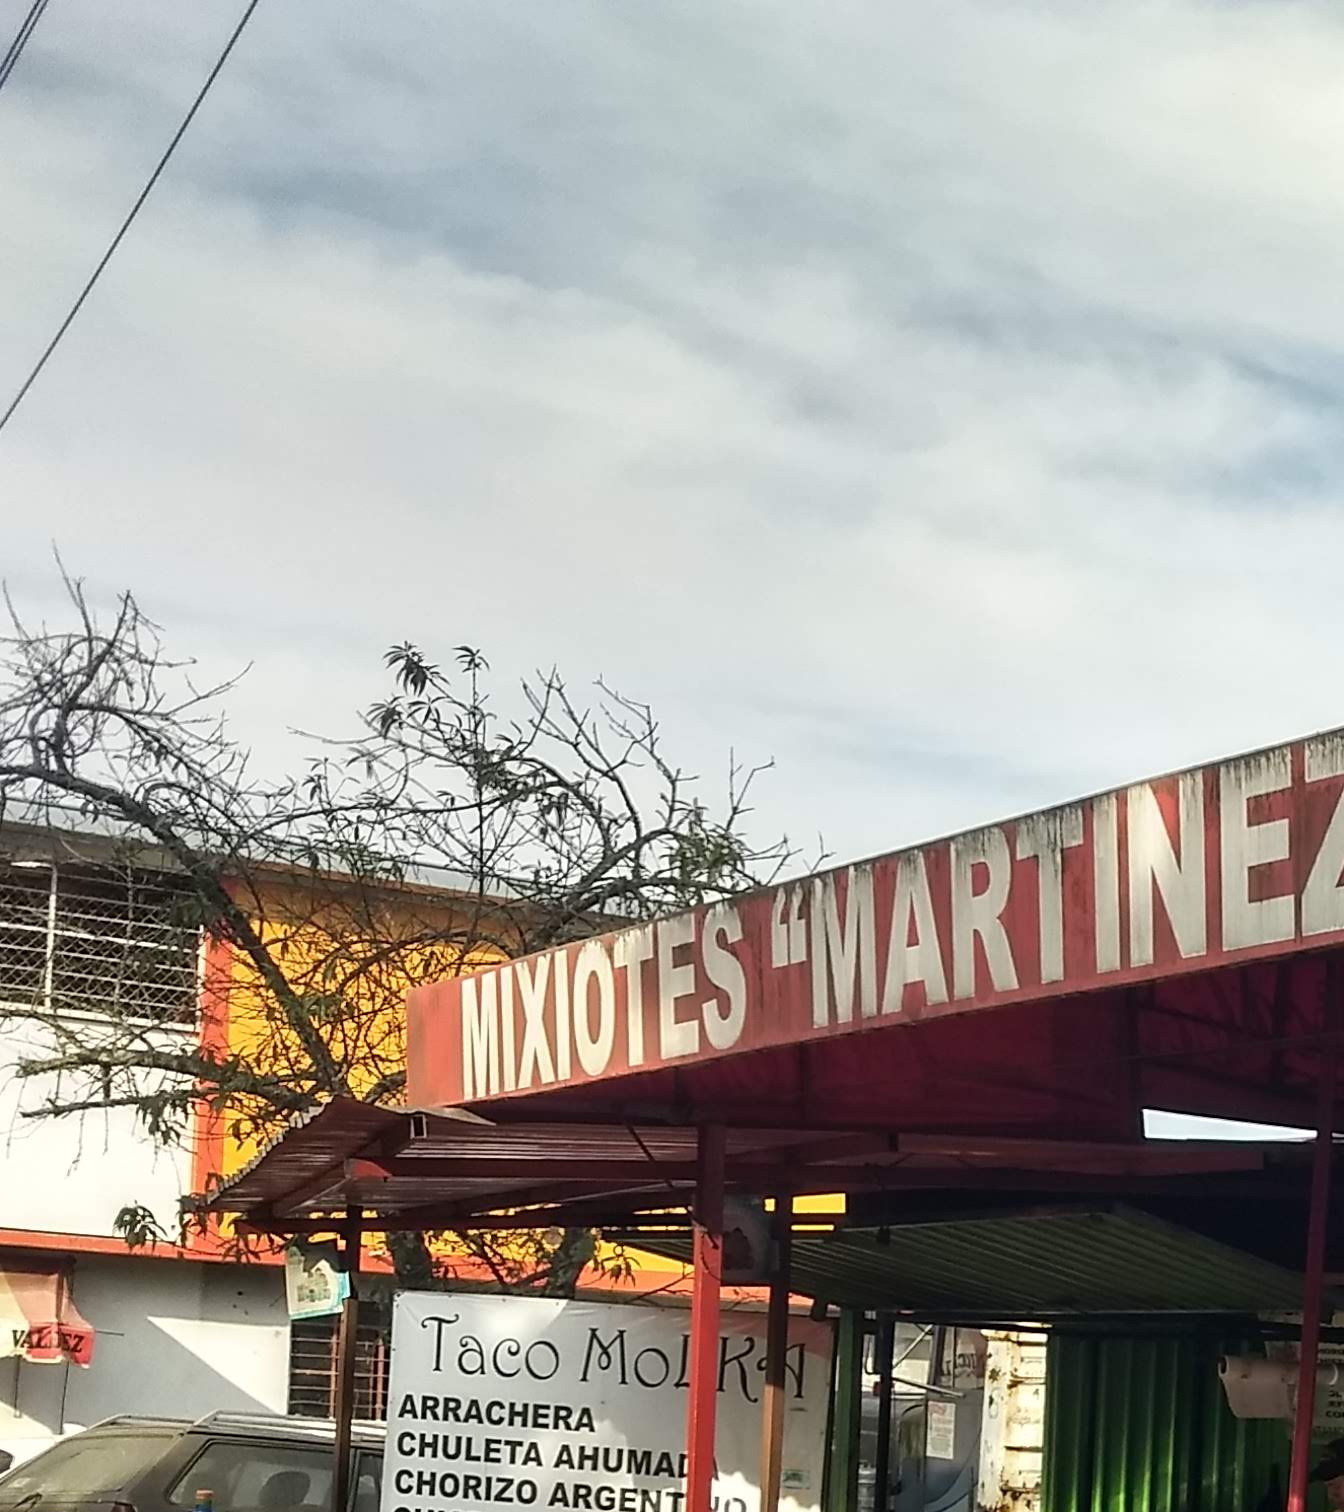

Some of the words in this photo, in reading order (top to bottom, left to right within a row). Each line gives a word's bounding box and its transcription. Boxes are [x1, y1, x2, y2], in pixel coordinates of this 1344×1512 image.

[459, 898, 747, 1100] MIXIOTES
[421, 1314, 560, 1380] Taco
[398, 1394, 595, 1432] ARRACHERA
[397, 1432, 543, 1466] CHULETA
[394, 1469, 538, 1504] CHORIZO
